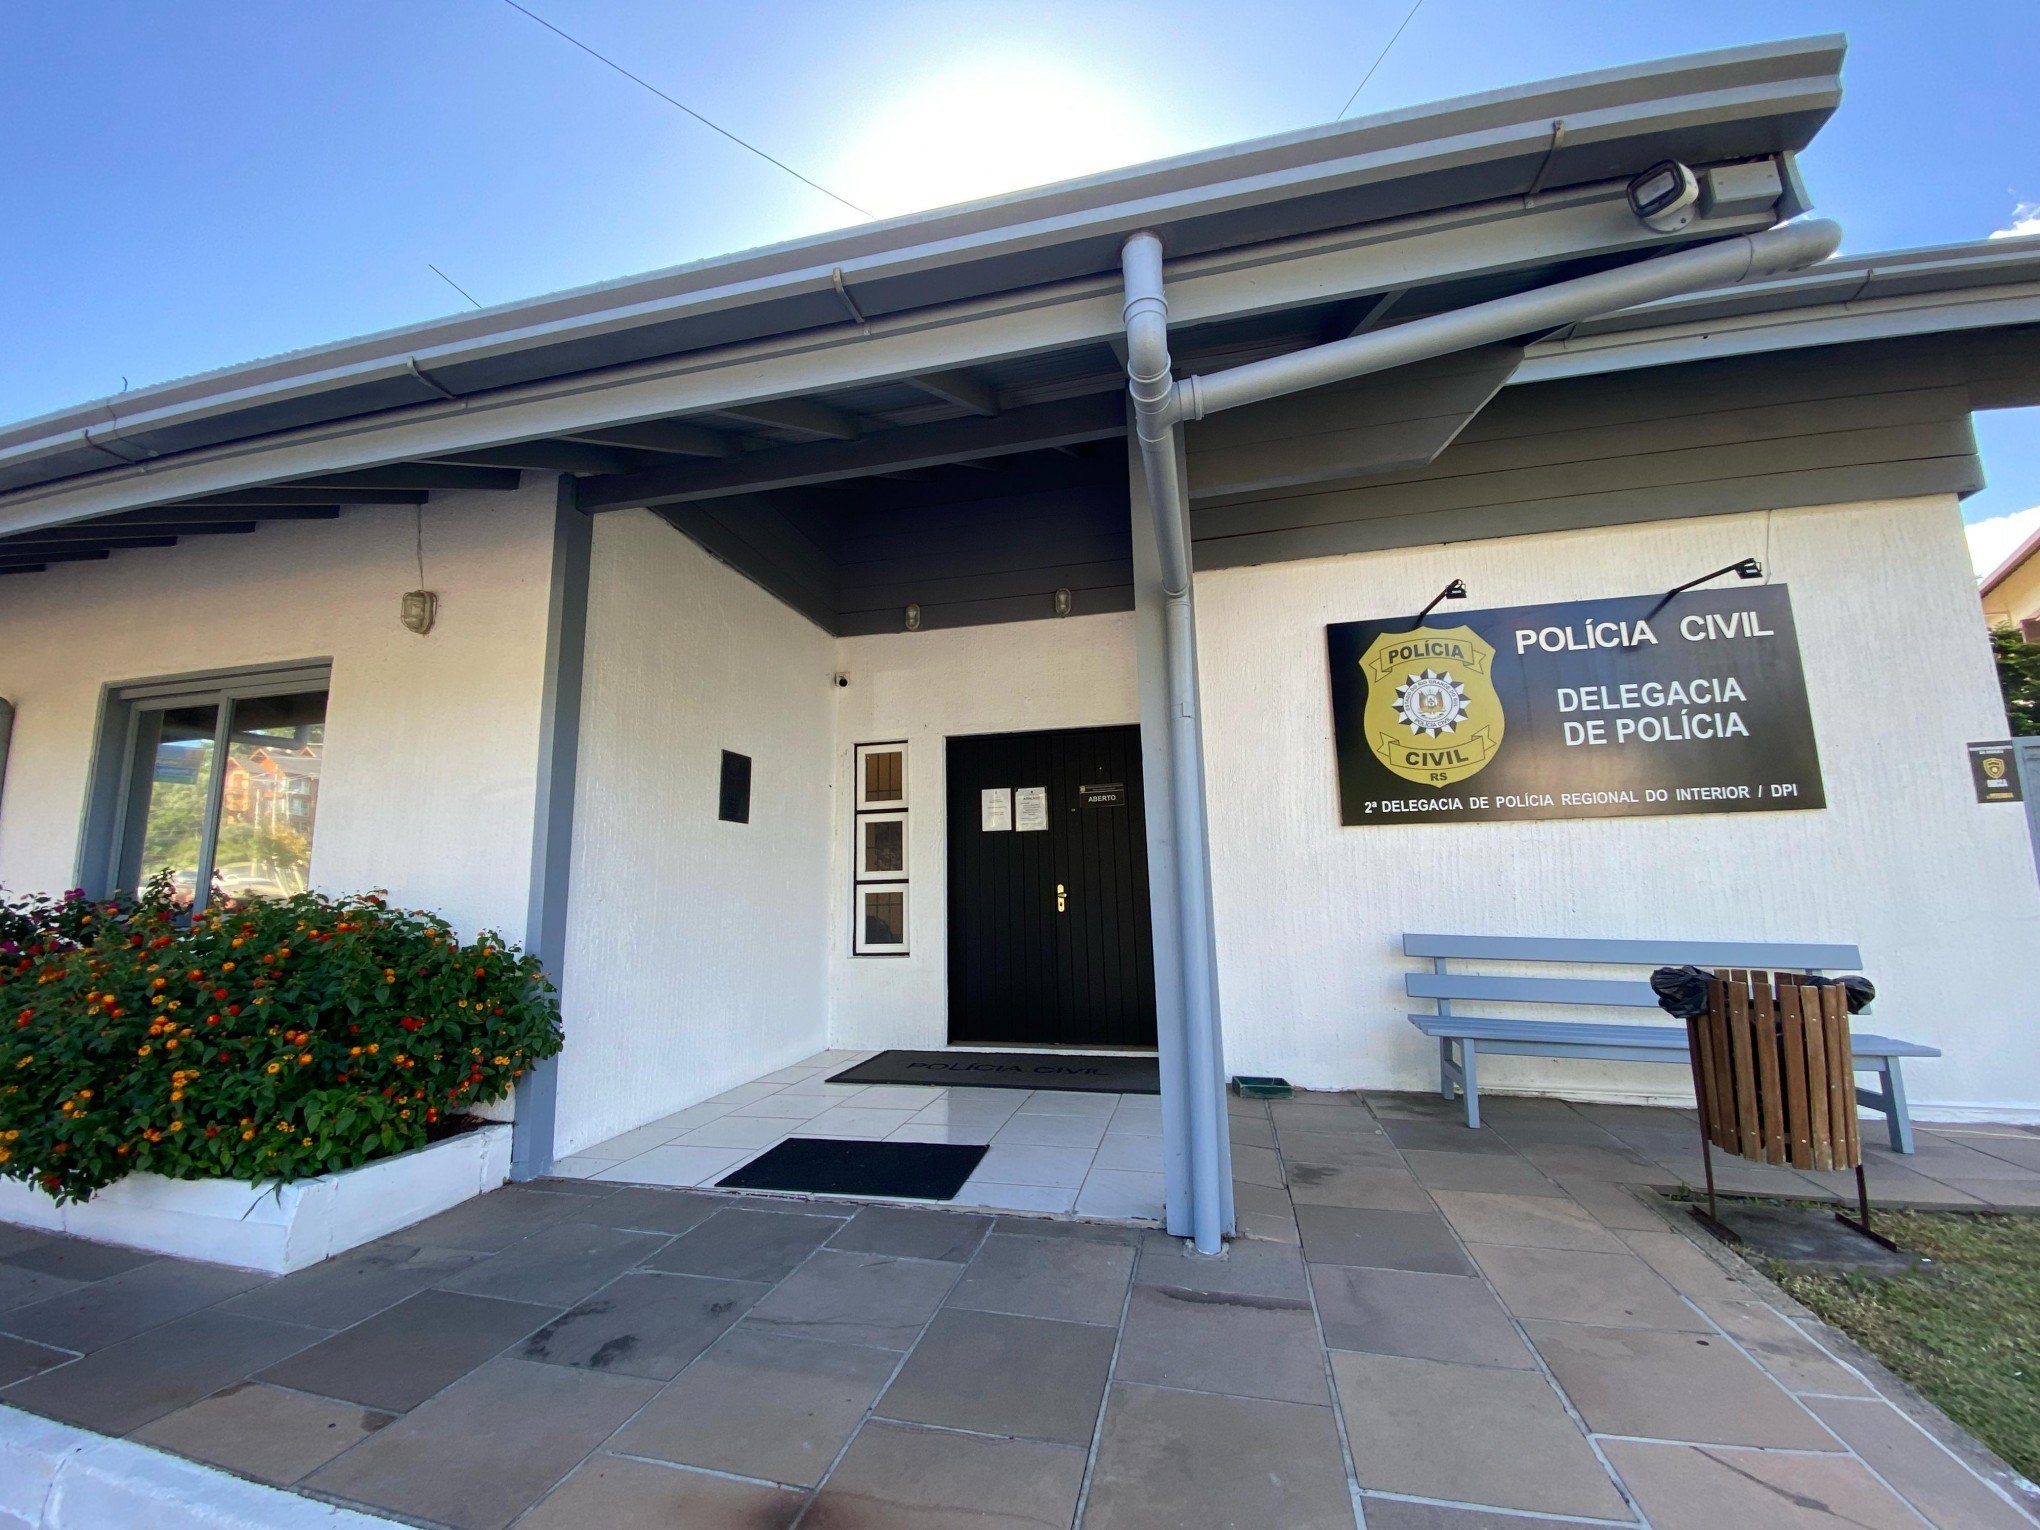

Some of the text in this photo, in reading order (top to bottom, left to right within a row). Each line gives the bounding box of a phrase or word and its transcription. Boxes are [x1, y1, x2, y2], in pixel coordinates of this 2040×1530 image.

[1515, 611, 1774, 655] POLÍCIA CIVIL
[1388, 640, 1464, 664] POLÍCIA
[1557, 677, 1747, 713] DELEGACIA
[1563, 708, 1750, 746] DE POLÍCIA
[1405, 749, 1469, 767] CIVIL
[1430, 772, 1448, 782] RS
[1088, 794, 1117, 803] ABERTO
[1381, 797, 1463, 813] DELEGACIA
[1469, 796, 1490, 810] DE
[1496, 792, 1554, 809] POLÍCIA
[1561, 790, 1639, 806] REGIONAL
[1645, 789, 1668, 802] DO
[1675, 785, 1751, 801] INTERIOR
[1770, 783, 1798, 798] DPI
[906, 1061, 1110, 1076] POLÍCIA CIVIL
